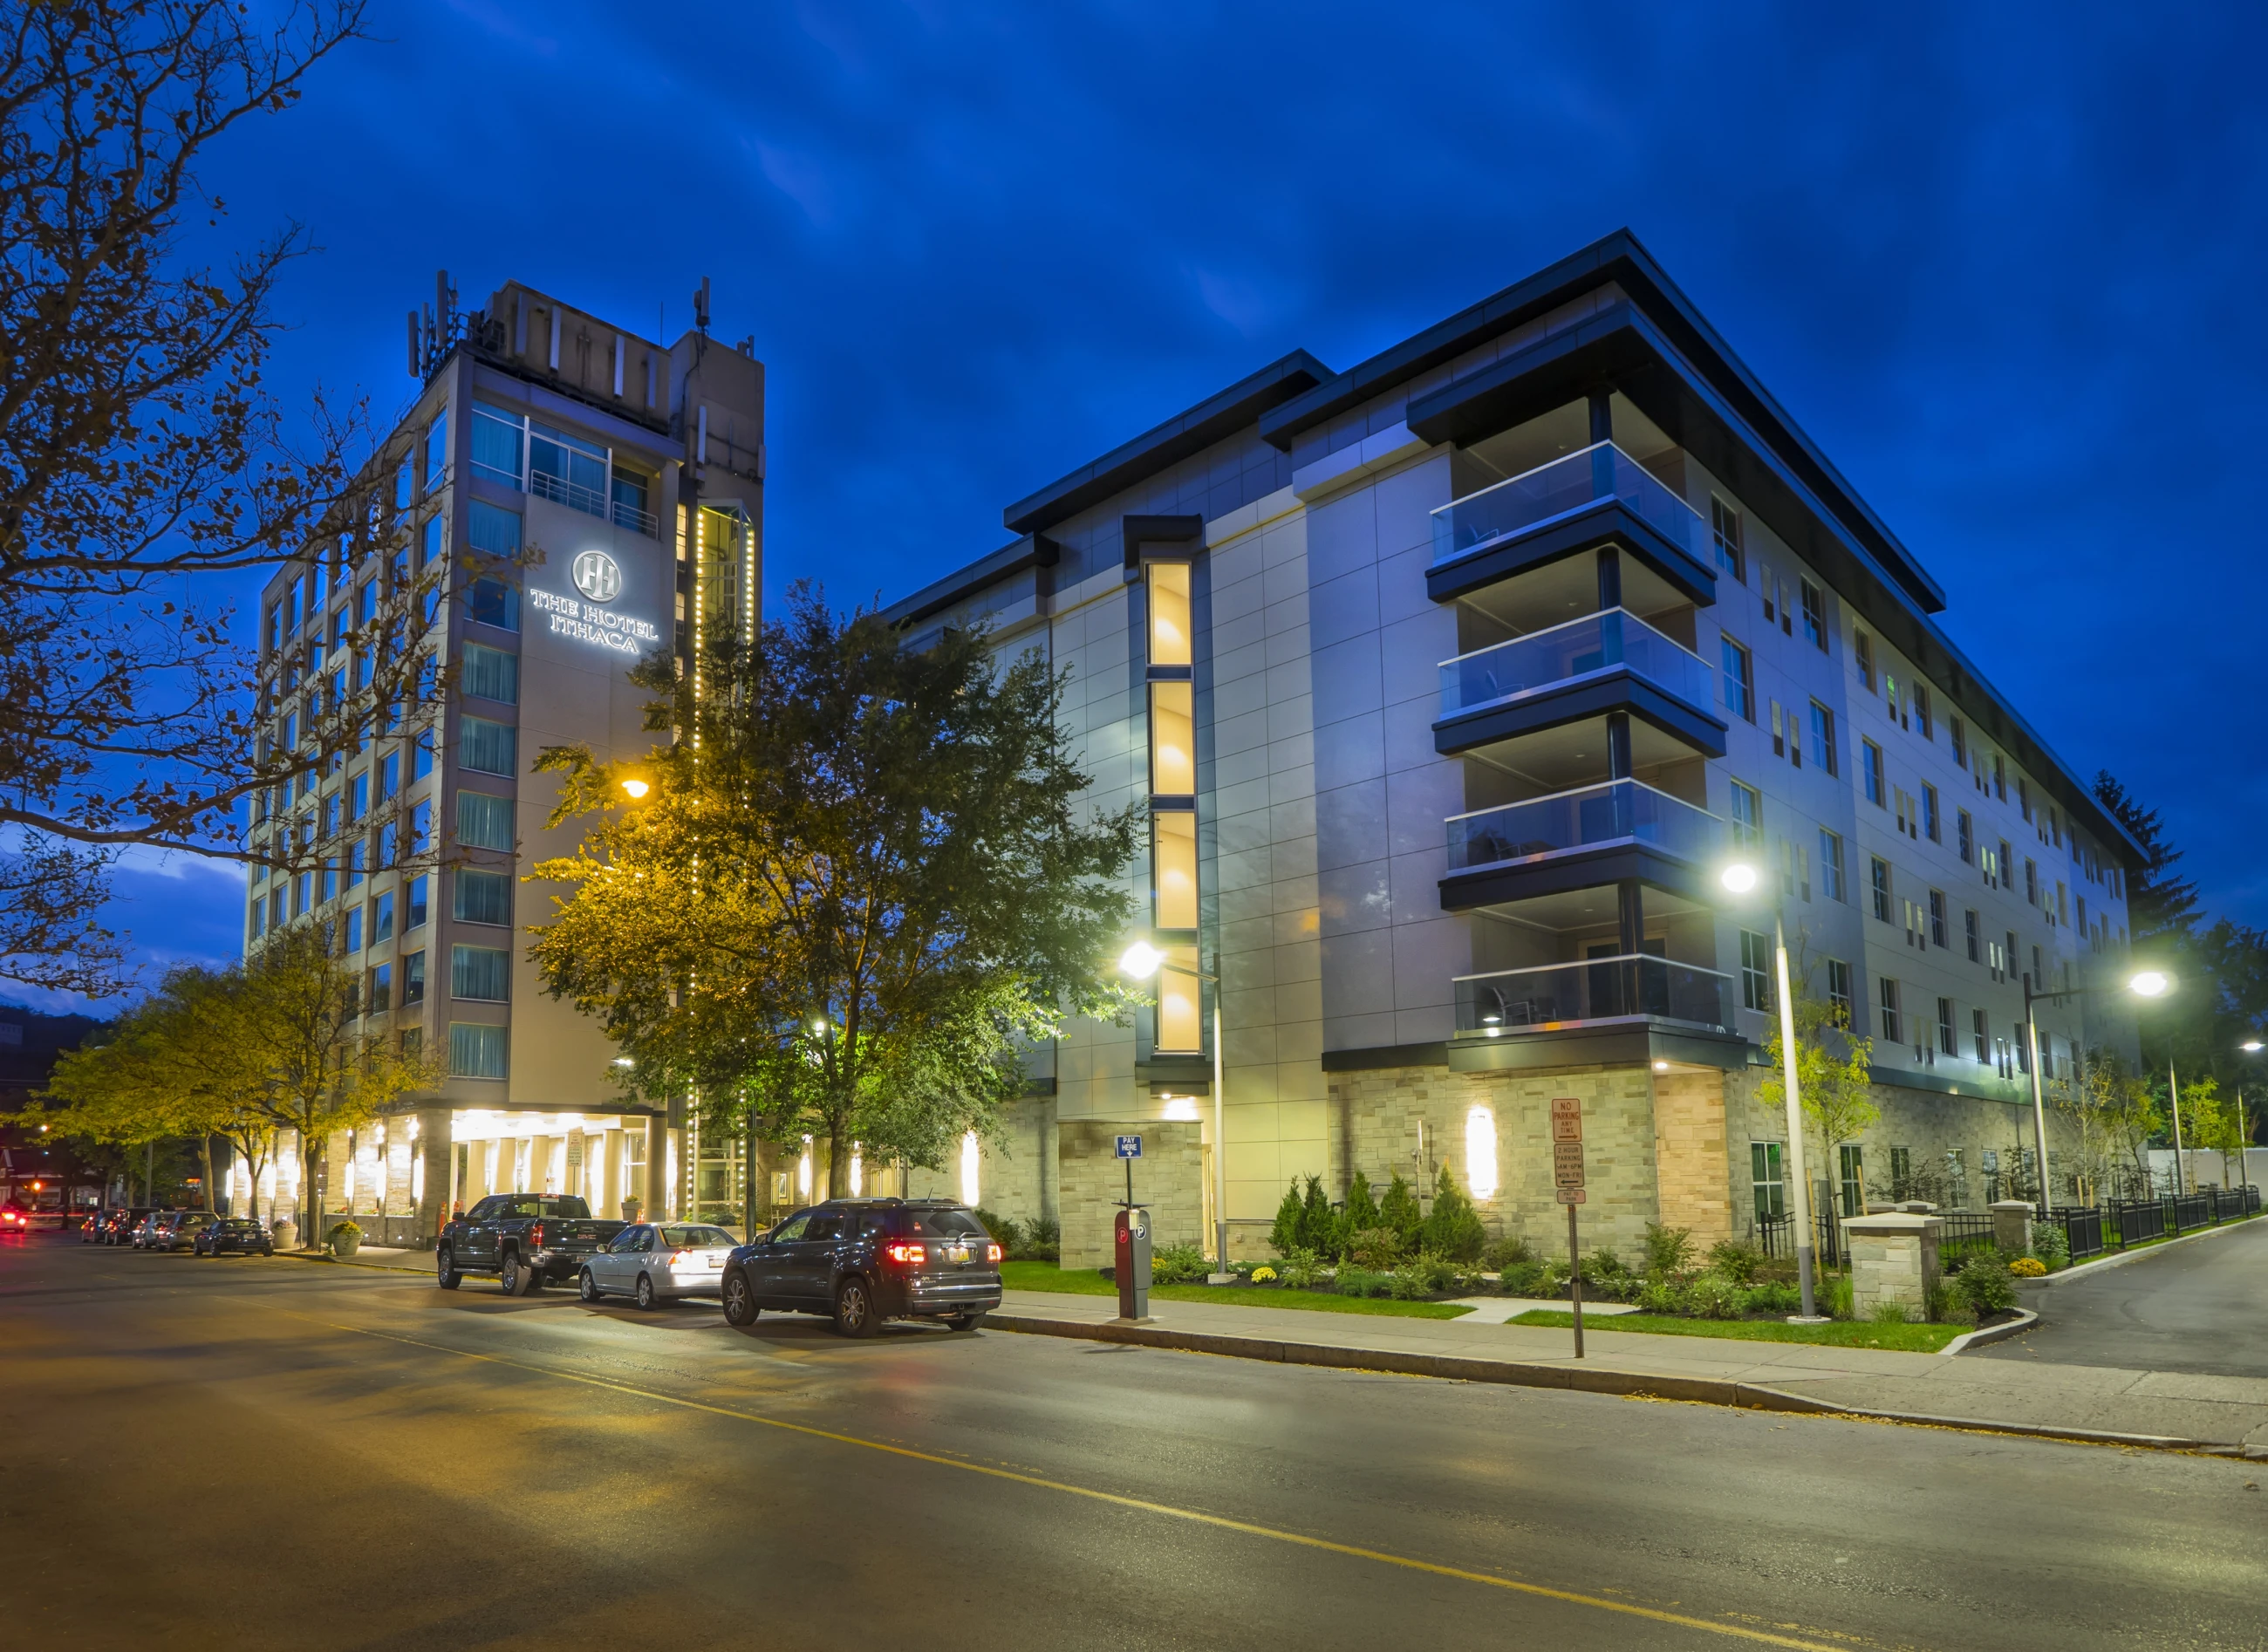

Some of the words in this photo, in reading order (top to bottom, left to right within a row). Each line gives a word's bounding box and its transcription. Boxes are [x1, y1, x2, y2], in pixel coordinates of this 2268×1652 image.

[530, 589, 578, 618] THE
[584, 604, 659, 641] HOTEL
[550, 614, 639, 653] ITHACA
[1561, 1102, 1571, 1110] NO
[1554, 1111, 1579, 1120] PARKING
[1120, 1230, 1125, 1239] P
[1137, 1225, 1144, 1237] P
